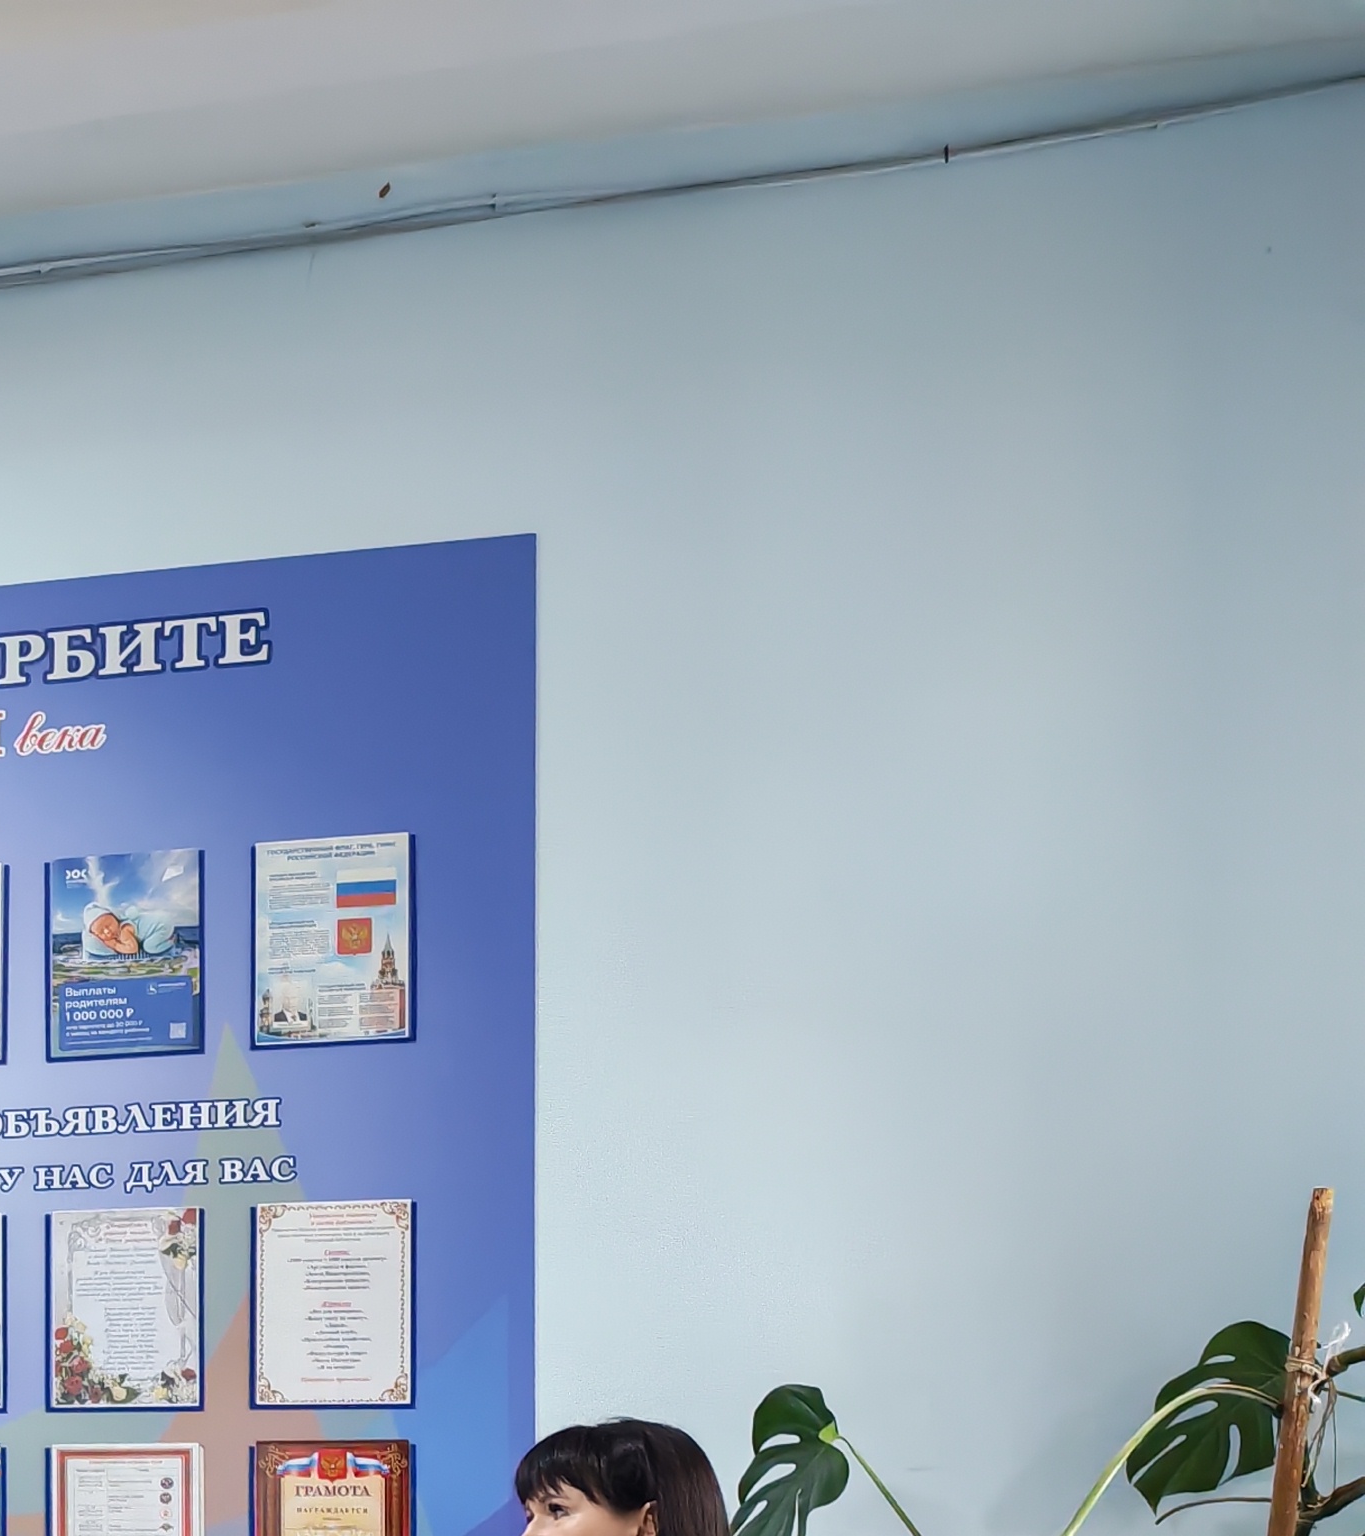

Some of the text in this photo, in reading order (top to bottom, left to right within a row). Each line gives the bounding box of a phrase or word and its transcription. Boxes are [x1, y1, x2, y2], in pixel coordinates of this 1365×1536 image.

[14, 712, 105, 755] века
[65, 986, 116, 997] Выплаты
[65, 997, 128, 1010] родителям
[34, 1162, 115, 1191] НАС
[124, 1159, 209, 1194] ДЛЯ
[219, 1155, 297, 1185] ВАС
[295, 1485, 372, 1497] ГРАМОТА
